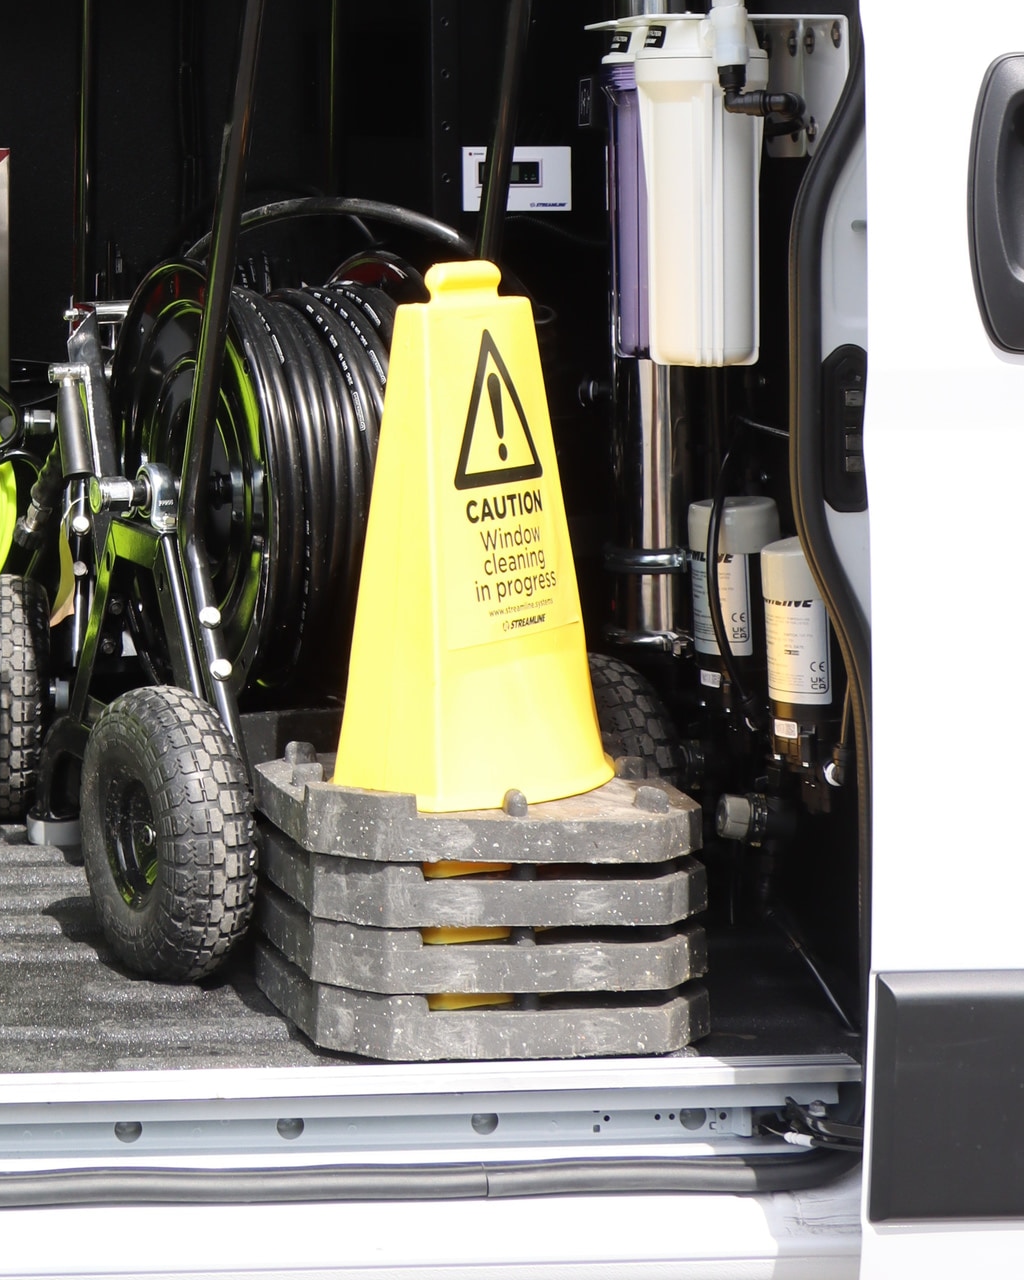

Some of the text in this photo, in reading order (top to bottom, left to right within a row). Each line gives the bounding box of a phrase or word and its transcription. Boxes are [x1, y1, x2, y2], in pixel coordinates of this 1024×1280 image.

[465, 489, 544, 524] CAUTION
[479, 524, 541, 552] Window
[483, 547, 546, 576] cleaning
[474, 570, 557, 603] in progress
[489, 597, 554, 617] www.streamline.systems
[510, 613, 547, 630] STREAMLINE
